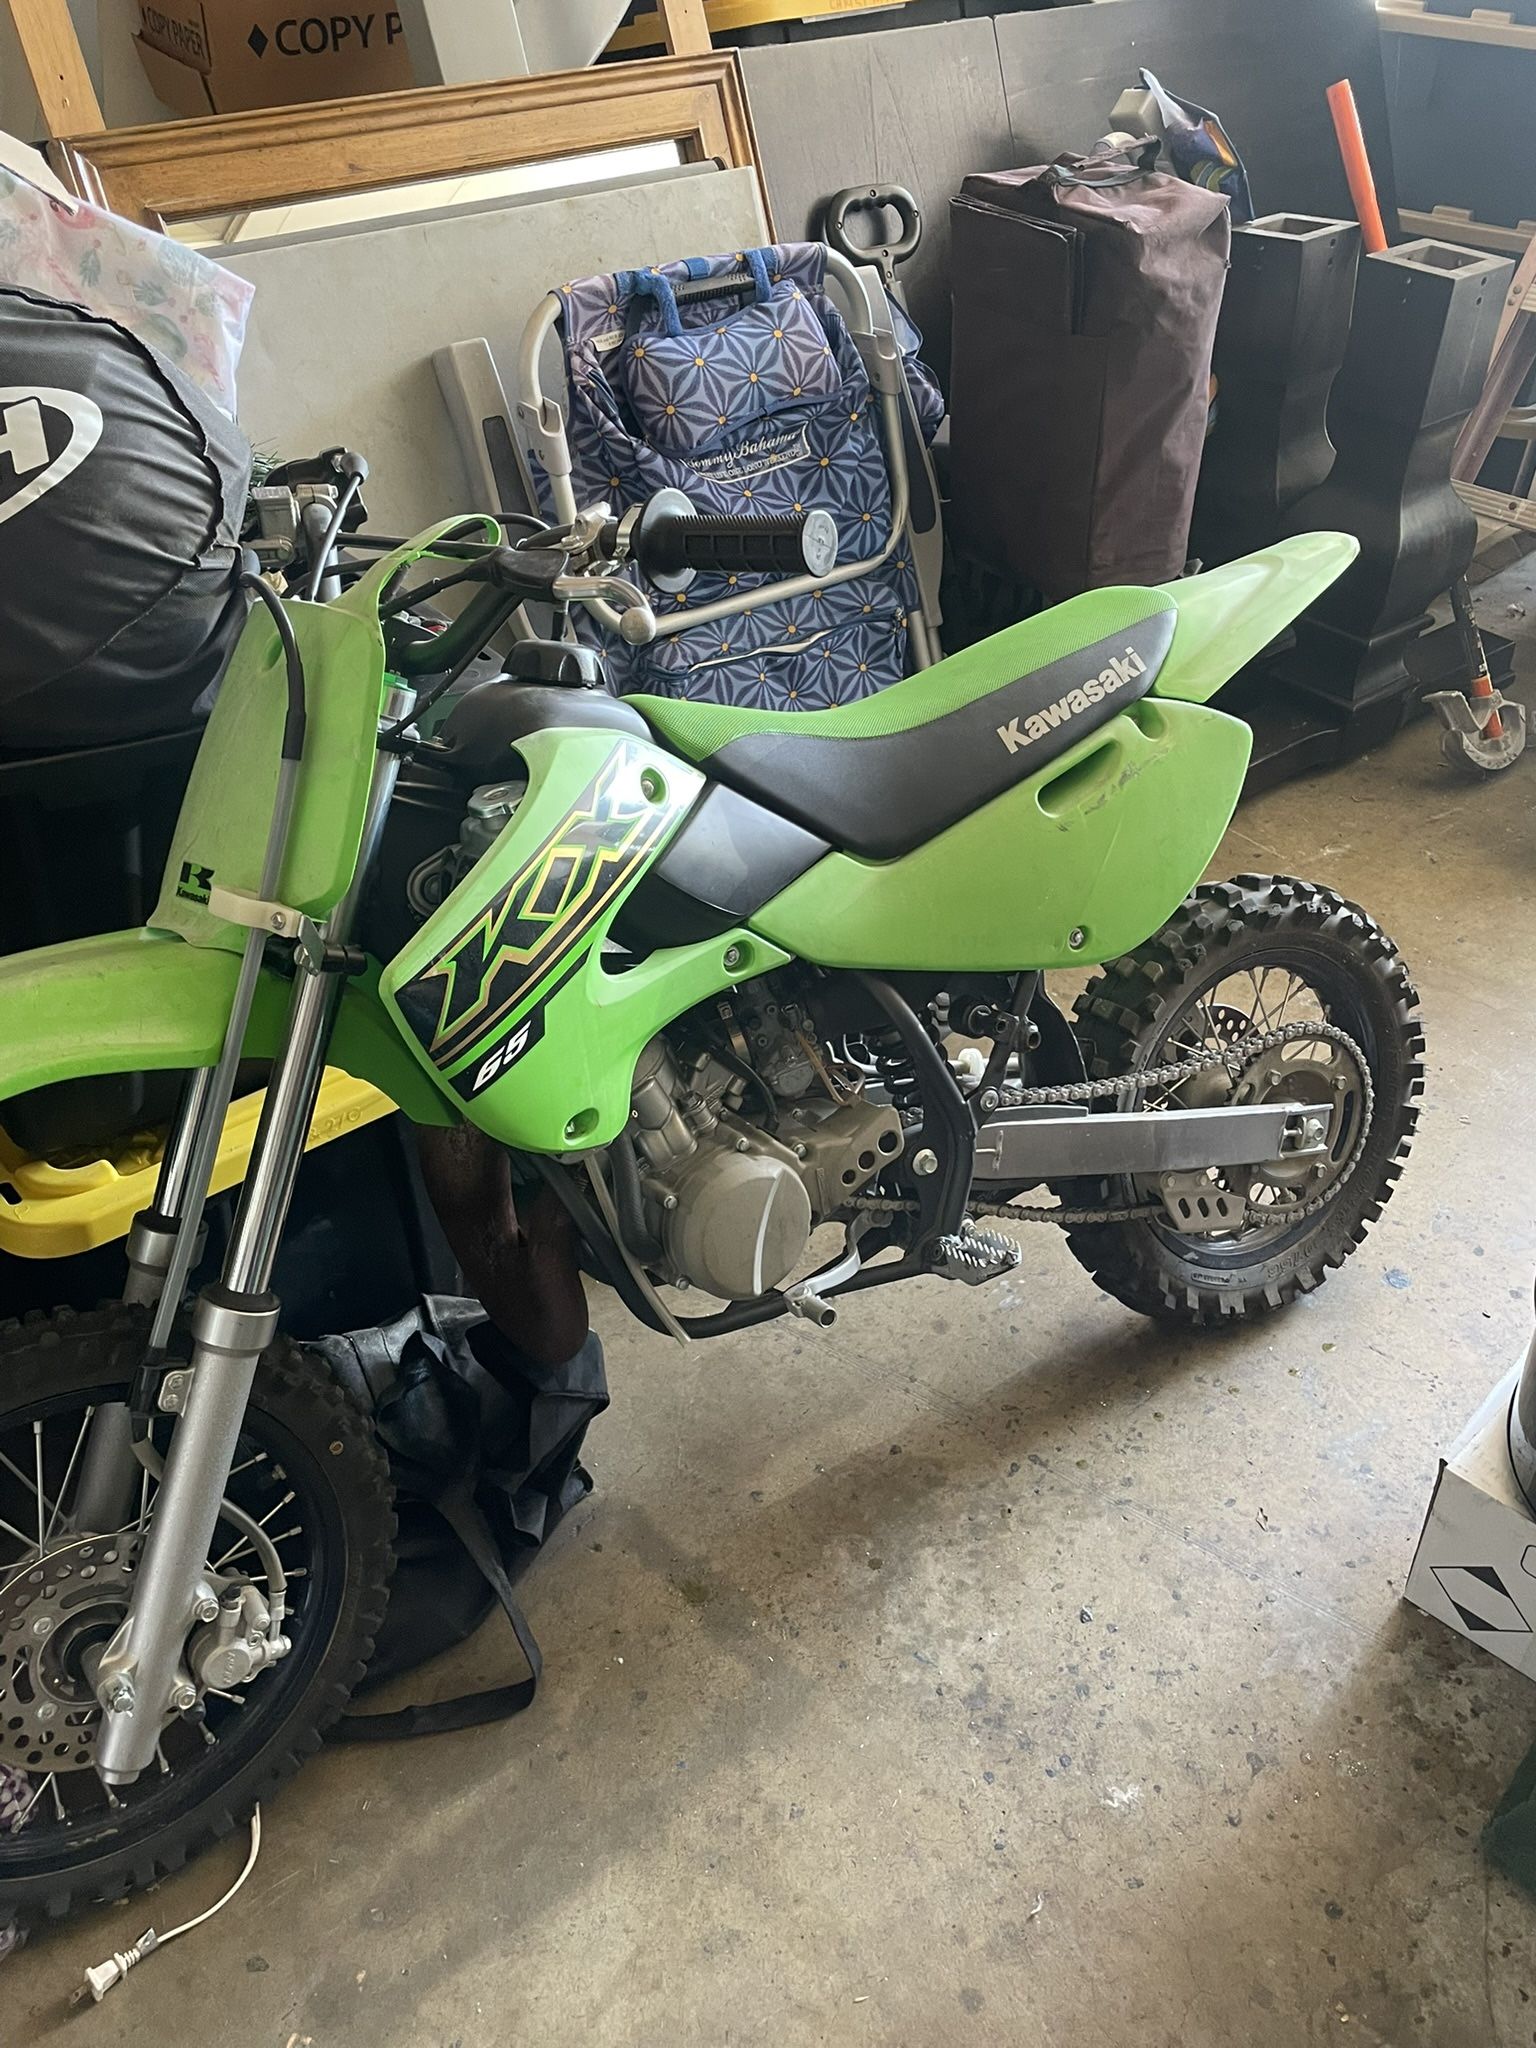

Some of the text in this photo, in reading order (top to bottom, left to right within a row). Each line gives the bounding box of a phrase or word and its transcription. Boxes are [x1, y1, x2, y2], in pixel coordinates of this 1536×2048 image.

[275, 14, 375, 56] COPY
[734, 430, 801, 459] Bahama
[997, 646, 1148, 755] Kawasaki
[472, 1020, 532, 1092] 65
